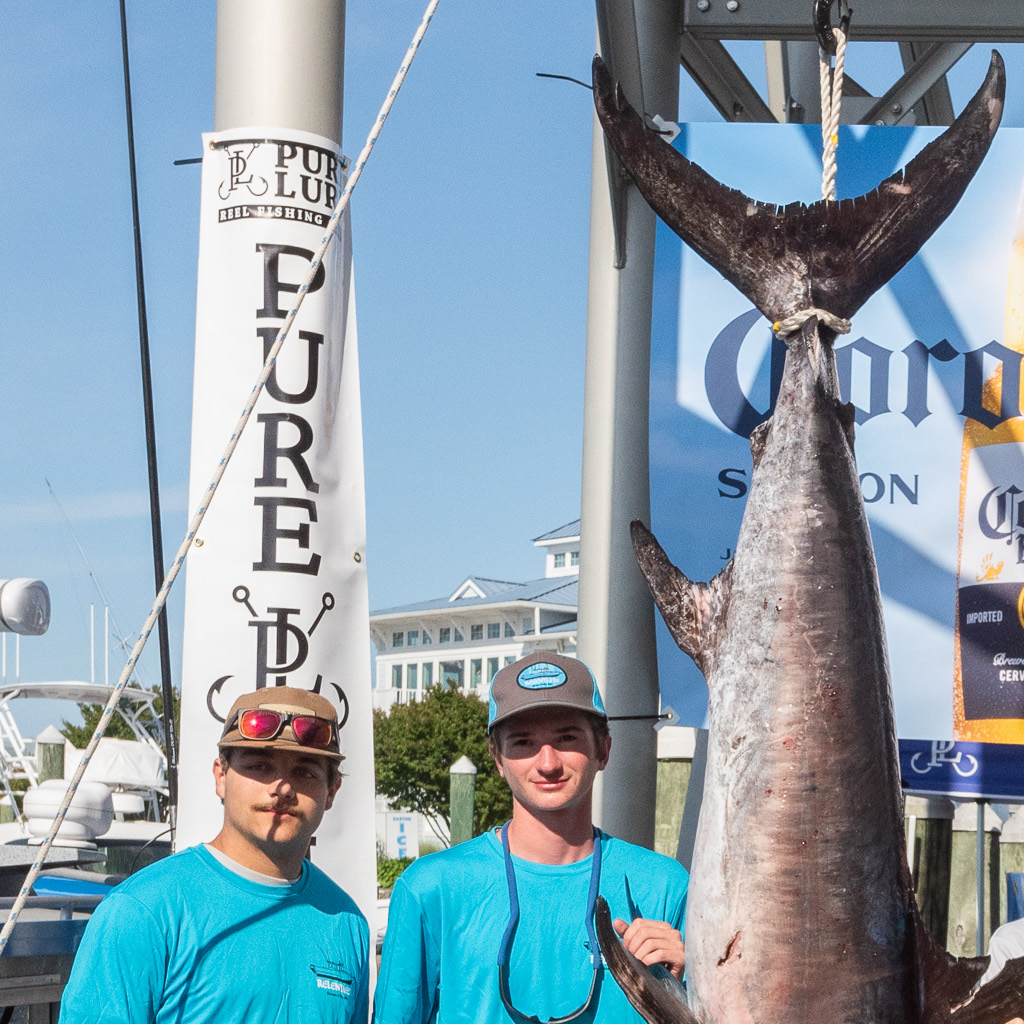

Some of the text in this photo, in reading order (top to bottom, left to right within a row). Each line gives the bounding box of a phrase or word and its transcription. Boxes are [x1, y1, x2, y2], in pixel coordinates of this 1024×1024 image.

[220, 206, 323, 225] REEL FISHING
[251, 243, 326, 577] PURE
[966, 610, 1004, 624] IMPORTED
